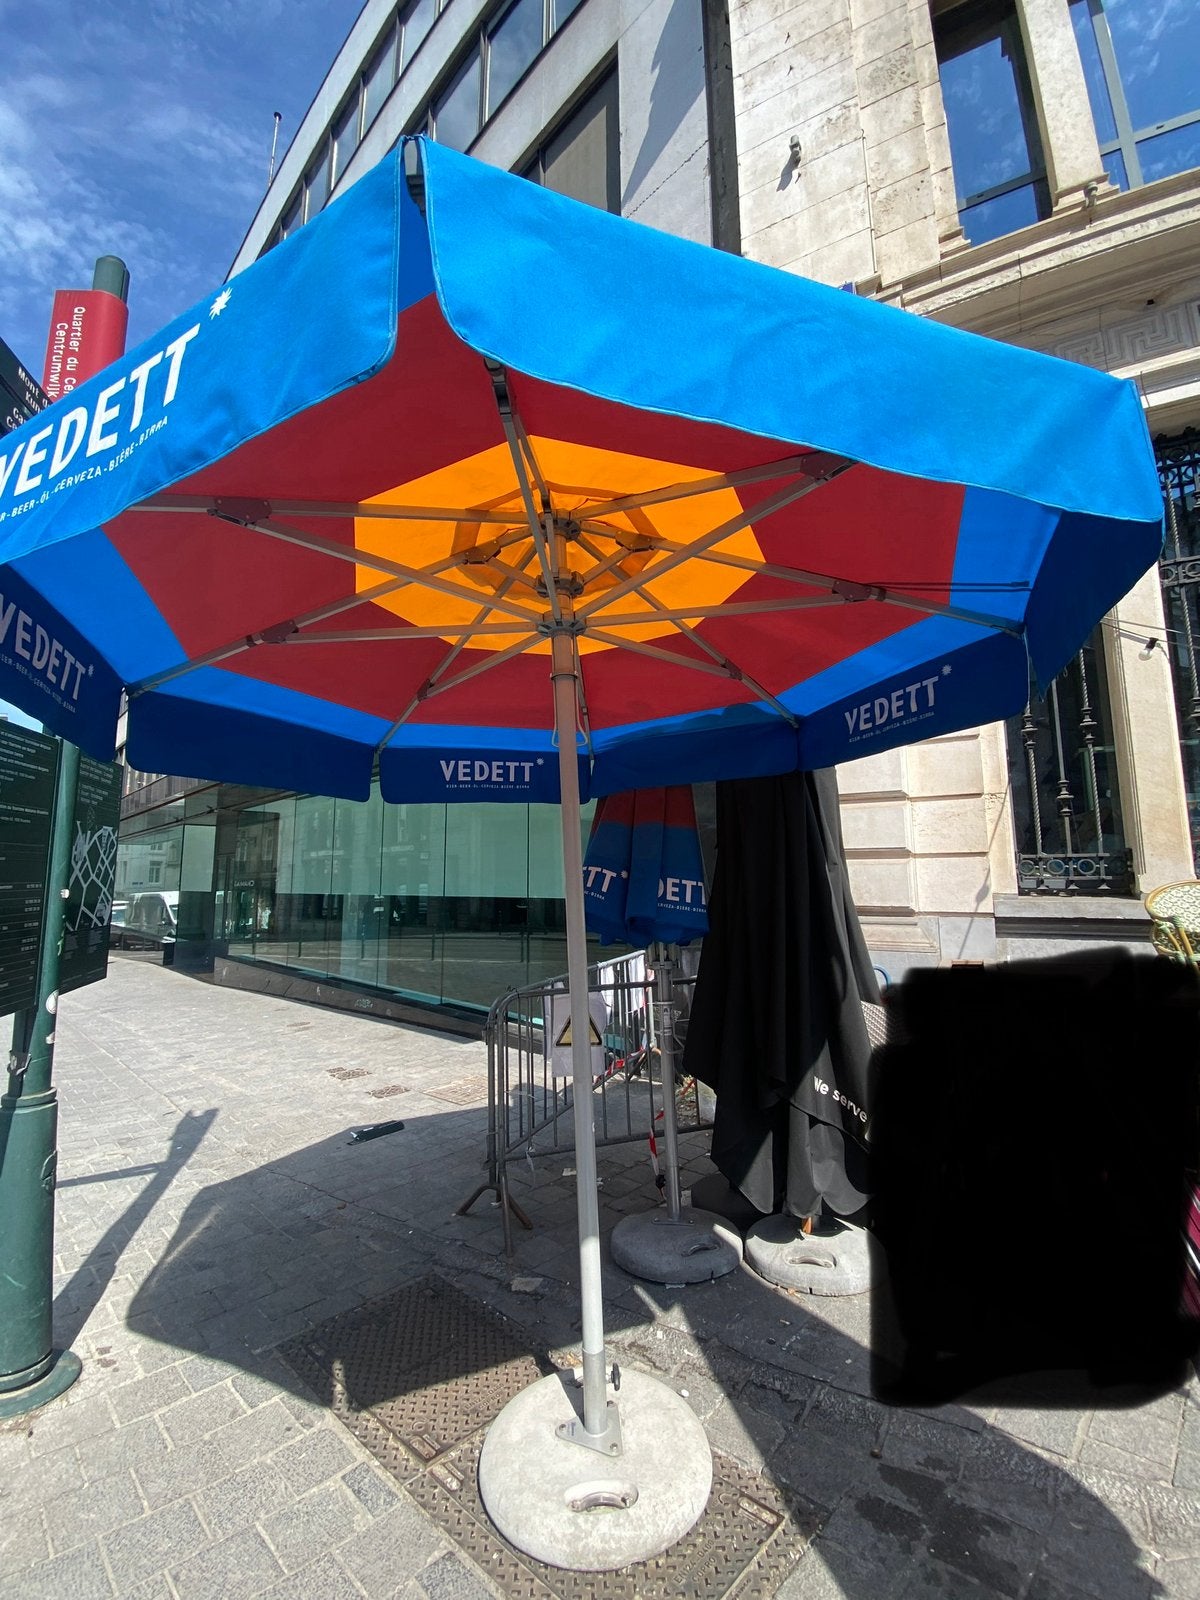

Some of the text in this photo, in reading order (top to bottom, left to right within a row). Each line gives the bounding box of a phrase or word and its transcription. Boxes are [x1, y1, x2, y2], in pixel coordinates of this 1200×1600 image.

[69, 306, 86, 352] Quartier
[18, 366, 40, 399] Mont
[46, 322, 68, 397] Centrumwijk
[66, 357, 79, 371] du
[0, 323, 201, 498] VEDETT
[0, 593, 86, 701] VEDETT
[844, 676, 939, 735] VEDETT
[439, 760, 534, 782] VEDETT
[814, 1076, 867, 1123] We serve
